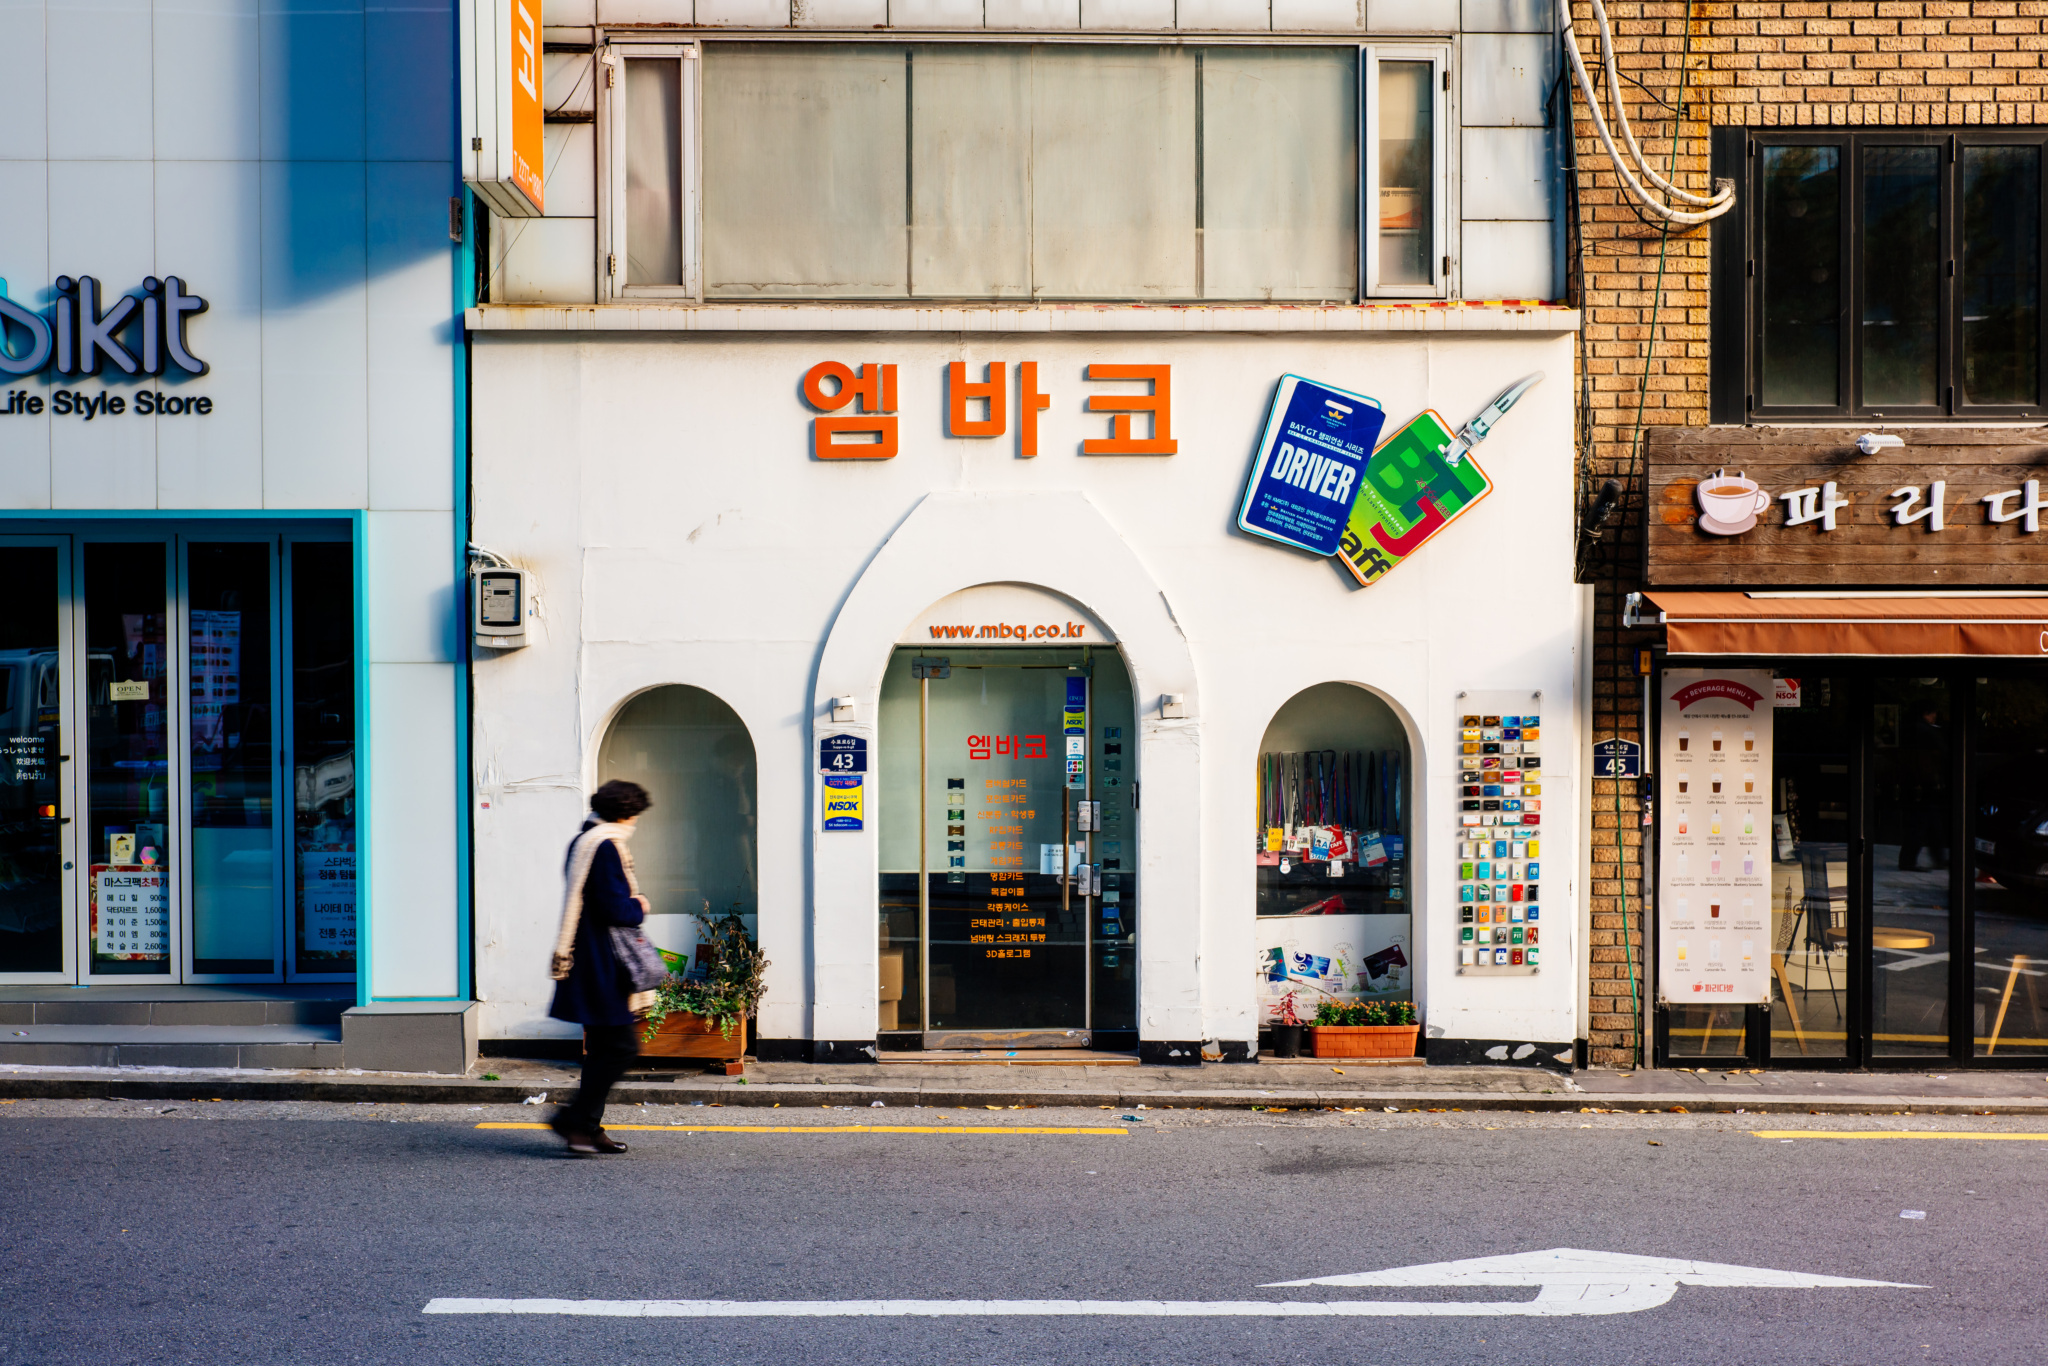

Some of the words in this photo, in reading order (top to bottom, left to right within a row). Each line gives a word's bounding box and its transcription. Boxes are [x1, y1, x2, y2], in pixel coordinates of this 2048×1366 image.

[513, 150, 518, 174] T
[52, 390, 125, 421] Style
[133, 390, 213, 415] Store
[803, 360, 1178, 460] 엠바코
[1288, 421, 1306, 432] BAT
[1305, 427, 1317, 437] GT
[1317, 431, 1344, 447] 챔피언십
[1344, 441, 1365, 454] 시리즈
[1270, 441, 1356, 505] DRIVER
[1374, 499, 1406, 532] Jerusalem
[930, 622, 1086, 640] www.mbq.co.kr
[1689, 685, 1725, 697] BEVERAGE
[1726, 687, 1746, 697] MENU
[967, 735, 1048, 760] 엠바코
[832, 753, 854, 769] 43
[1605, 758, 1626, 773] 45
[985, 794, 1027, 804] 포인트카드
[827, 801, 859, 811] NSOK
[977, 810, 1002, 820] 신분증
[1011, 810, 1036, 820] 학생증
[990, 841, 1024, 850] 교통카드
[990, 856, 1024, 866] 게임카드
[990, 872, 1024, 881] 명함카드
[104, 877, 169, 888] 마스크팩초특가
[991, 887, 1025, 897] 목걸이줄
[987, 903, 1029, 912] 각종케이스
[971, 918, 1004, 928] 근태관리
[1012, 918, 1045, 927] 출입통제
[970, 934, 995, 943] 넘버링
[996, 934, 1028, 943] 스크래치
[986, 949, 1031, 959] 3D홀로그램
[1705, 984, 1734, 992] 파리다방
